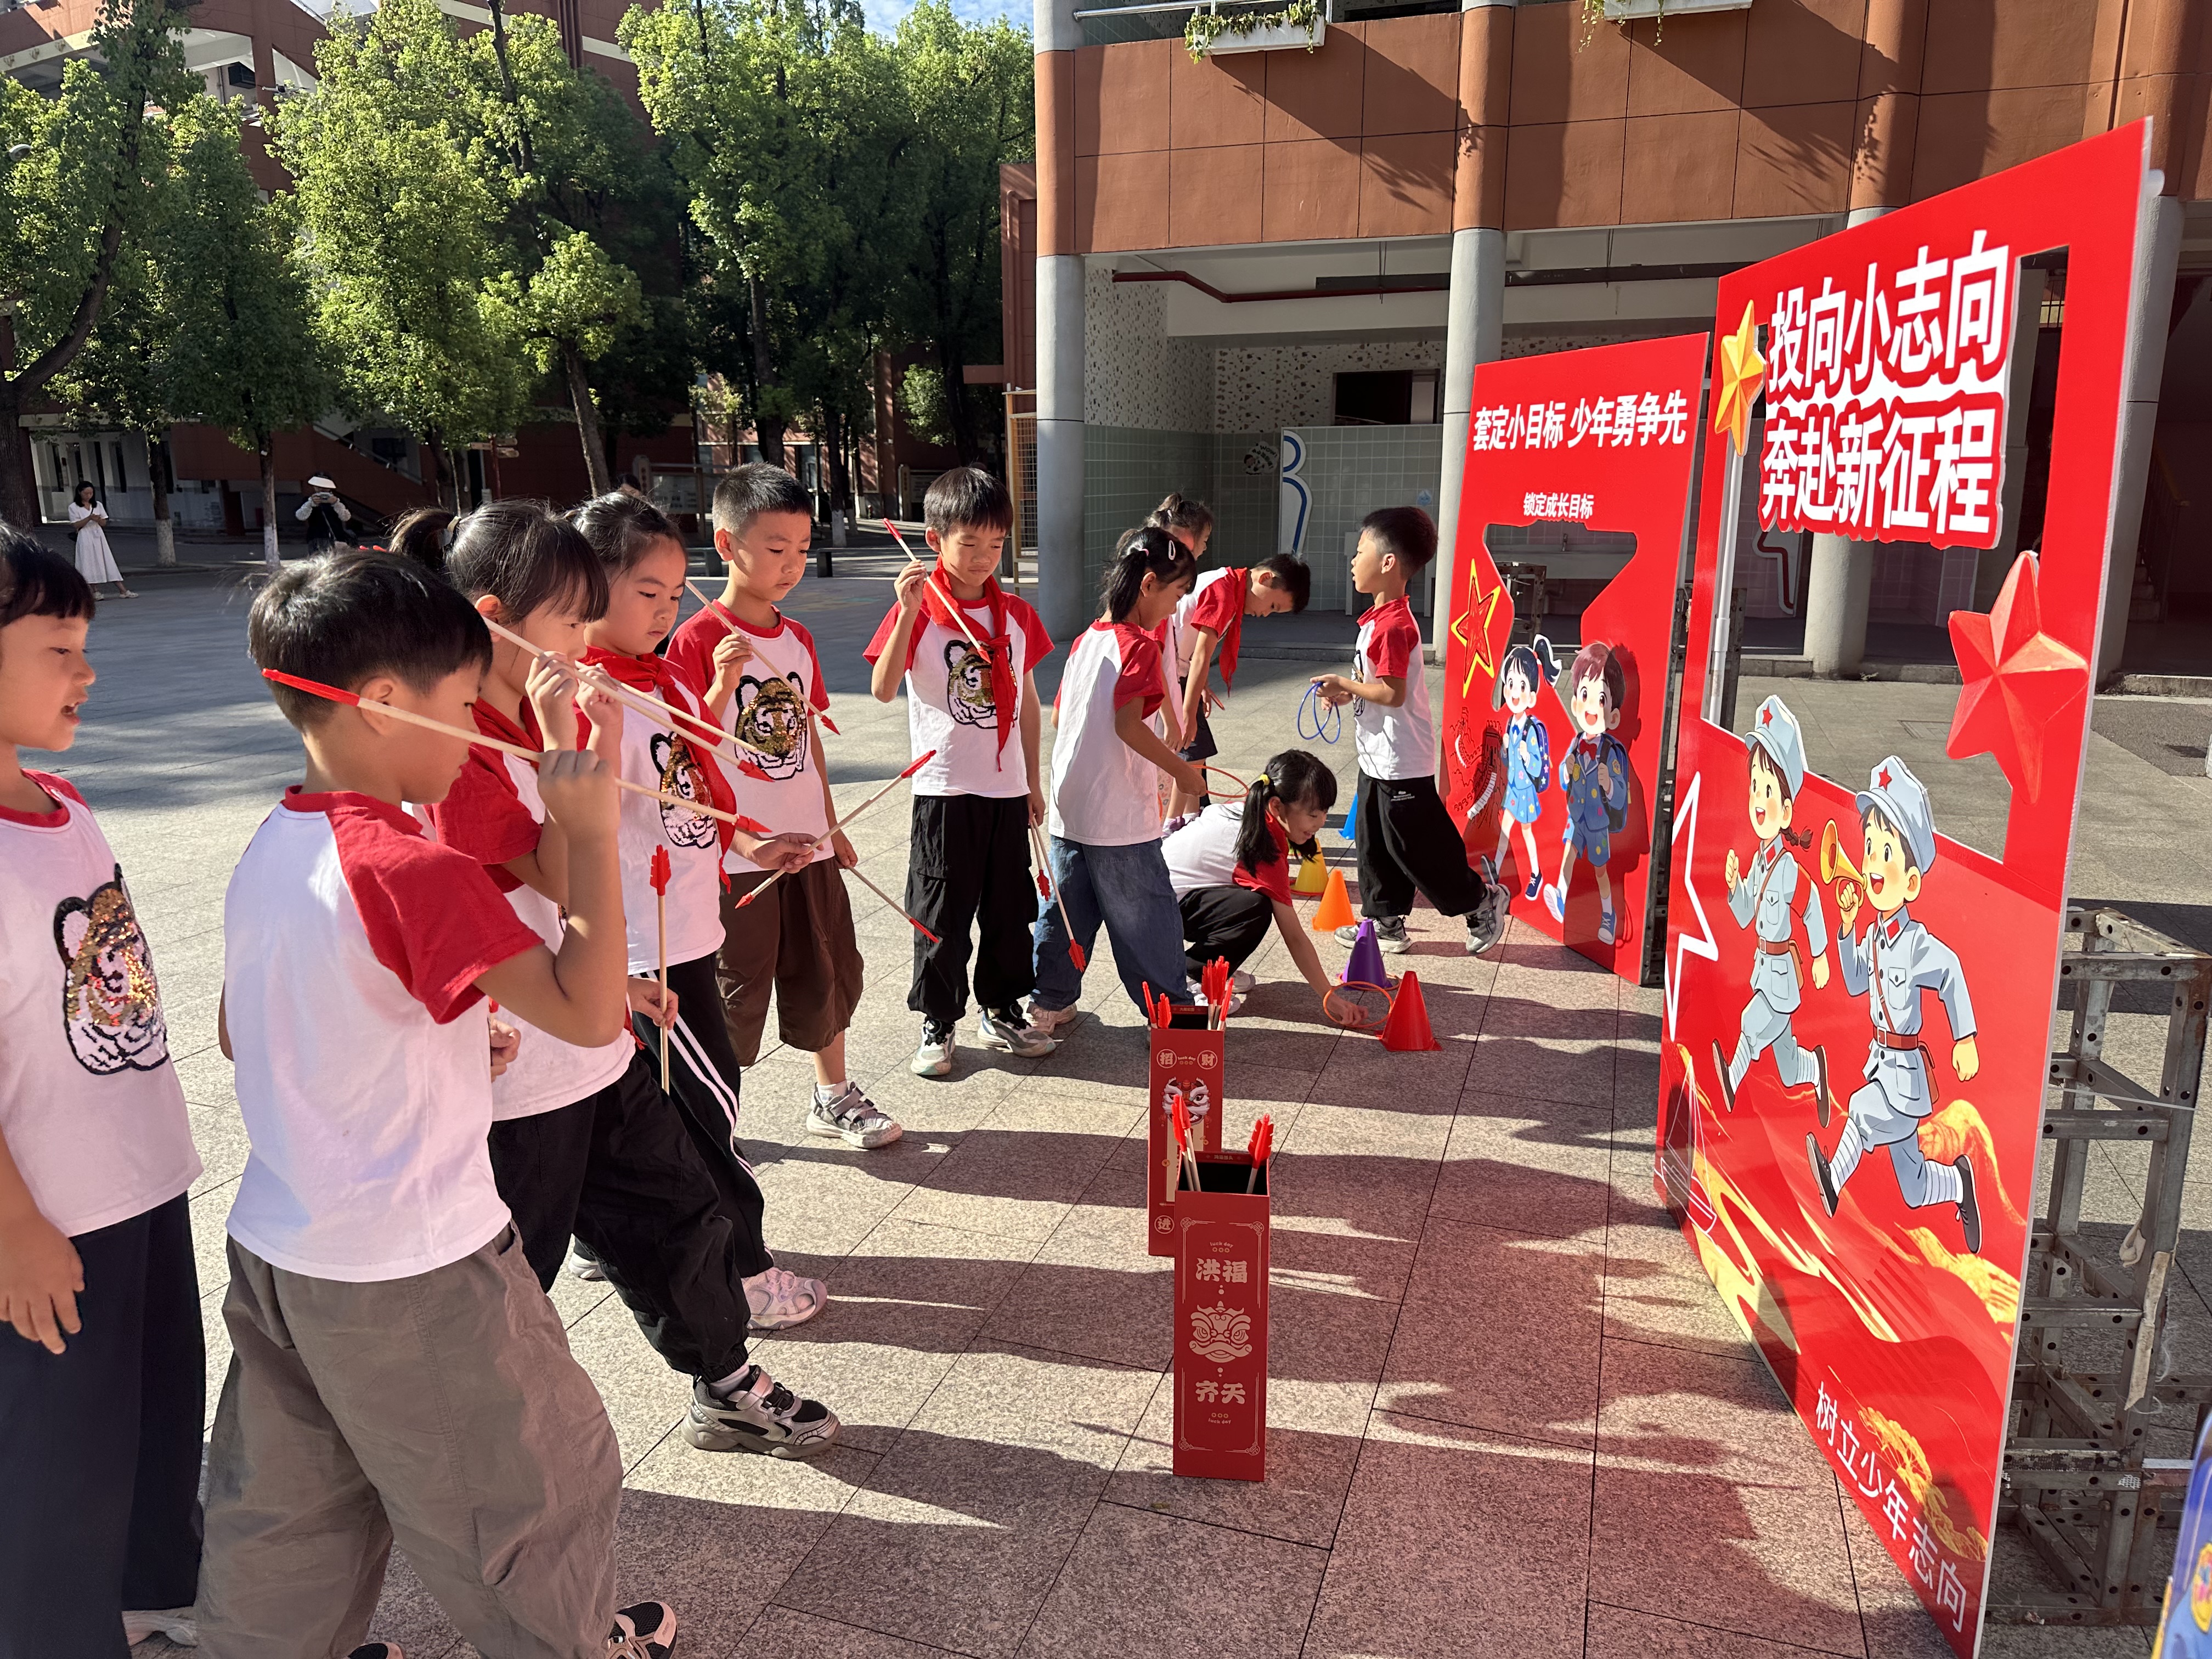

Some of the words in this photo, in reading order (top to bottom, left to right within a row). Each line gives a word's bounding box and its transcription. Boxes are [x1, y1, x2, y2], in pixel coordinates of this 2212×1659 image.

[1769, 230, 2009, 393] 投向小志向
[1473, 400, 1566, 452] 套定小目标
[1567, 390, 1688, 449] 少年勇争先
[1761, 406, 1996, 534] 奔赴新征程
[1523, 492, 1594, 519] 锁定成长目标
[1159, 1052, 1173, 1065] 招
[1201, 1053, 1215, 1066] 财
[1157, 1218, 1171, 1231] 进
[1195, 1257, 1248, 1283] 洪福
[1195, 1380, 1246, 1404] 齐天
[1815, 1380, 1967, 1633] 树立少年志向
